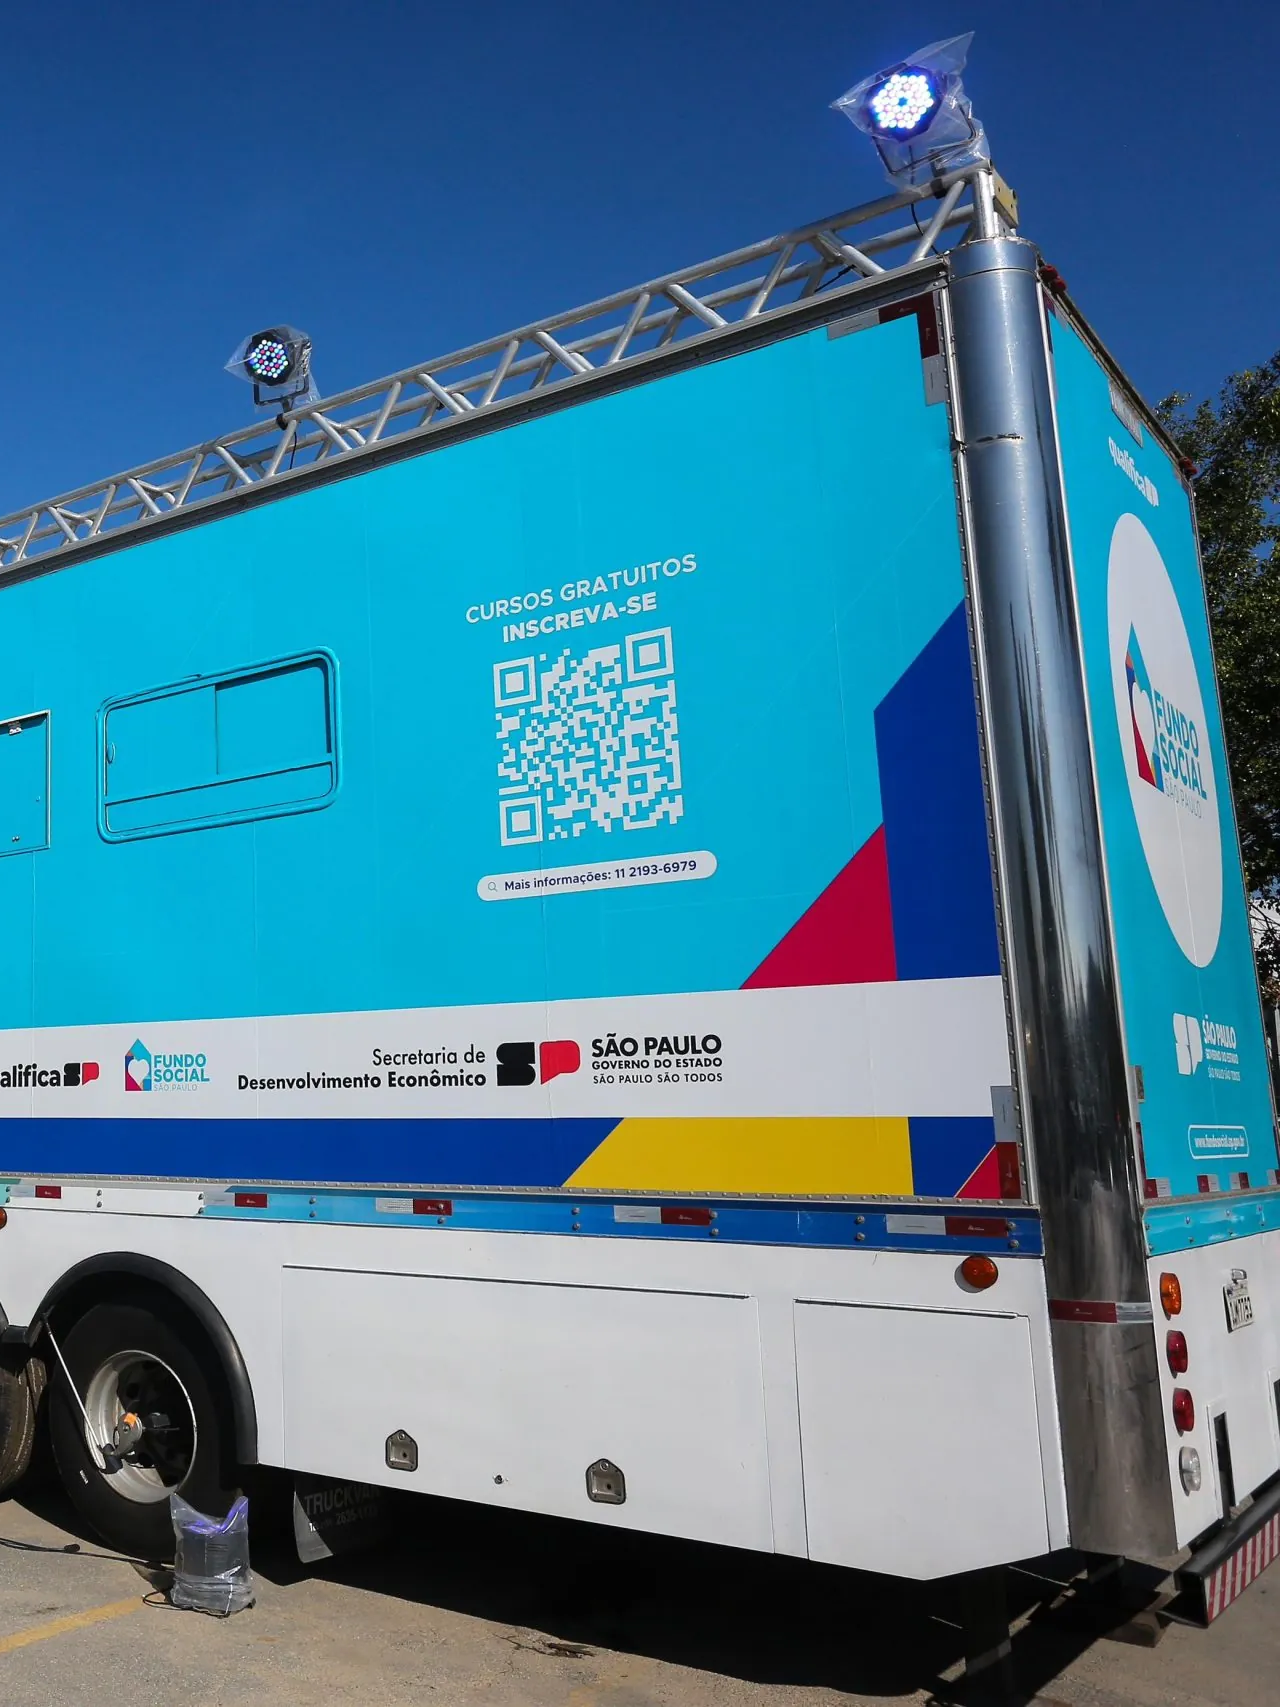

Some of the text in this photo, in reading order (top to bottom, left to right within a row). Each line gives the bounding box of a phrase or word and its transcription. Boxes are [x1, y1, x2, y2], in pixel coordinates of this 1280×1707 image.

[465, 553, 698, 624] CURSOS GRATUITOS
[502, 591, 658, 643] INSCREVA-SE
[1153, 688, 1199, 758] FUNDO
[1159, 732, 1208, 801] SOCIAL
[504, 859, 697, 891] Mais informações: 11 2193-6979
[591, 1032, 722, 1058] SÃO PAULO
[1215, 1023, 1237, 1050] PAULO
[154, 1053, 207, 1068] FUNDO
[372, 1044, 486, 1066] Secretaria de
[591, 1057, 723, 1070] GOVERNO DO ESTADO
[153, 1068, 210, 1083] SOCIAL
[153, 1082, 198, 1091] SÃO PAULO
[237, 1069, 487, 1090] Desenvolvimento Econômico
[593, 1071, 723, 1084] SÃO PAULO SÃO TODOS
